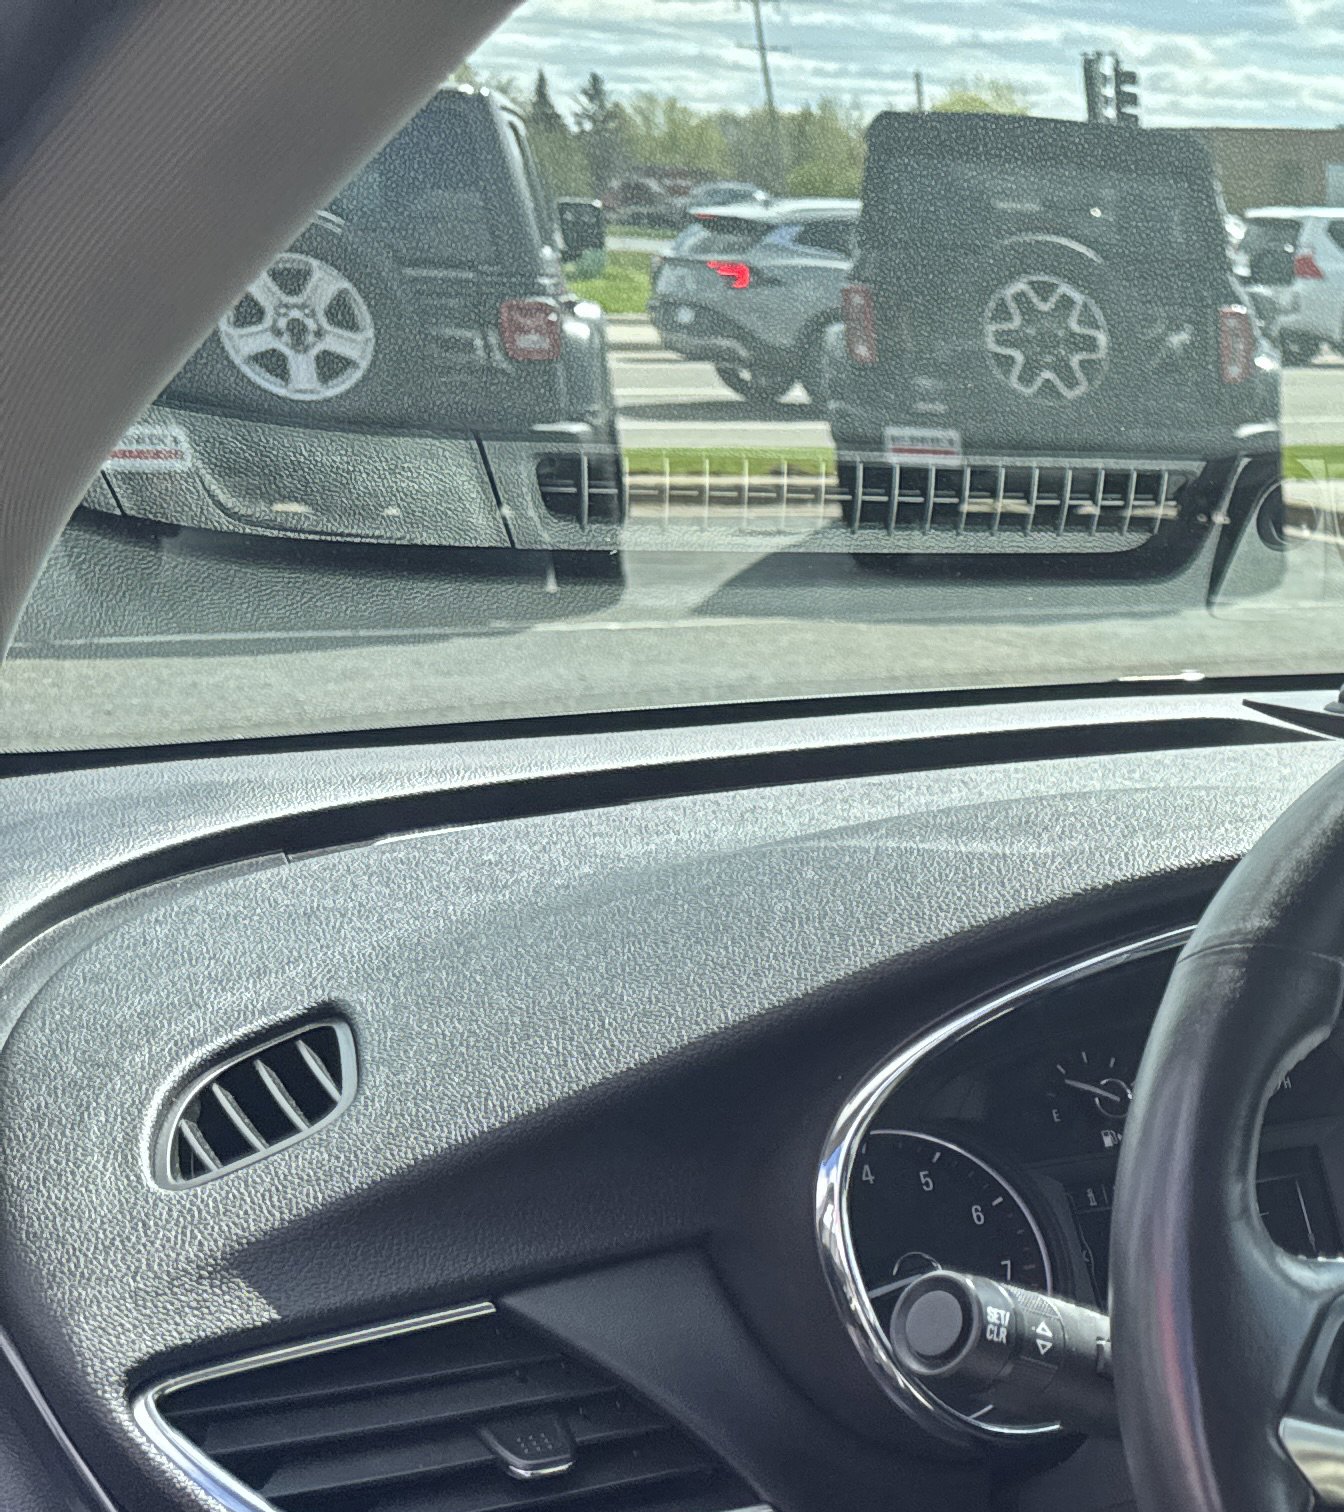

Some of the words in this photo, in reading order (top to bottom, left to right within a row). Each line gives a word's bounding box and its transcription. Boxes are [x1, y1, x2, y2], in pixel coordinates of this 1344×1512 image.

[1052, 1109, 1061, 1122] E
[861, 1164, 875, 1184] 4
[919, 1170, 934, 1191] 5
[971, 1205, 985, 1225] 6
[1000, 1260, 1012, 1281] 7
[986, 1324, 1008, 1344] CLR
